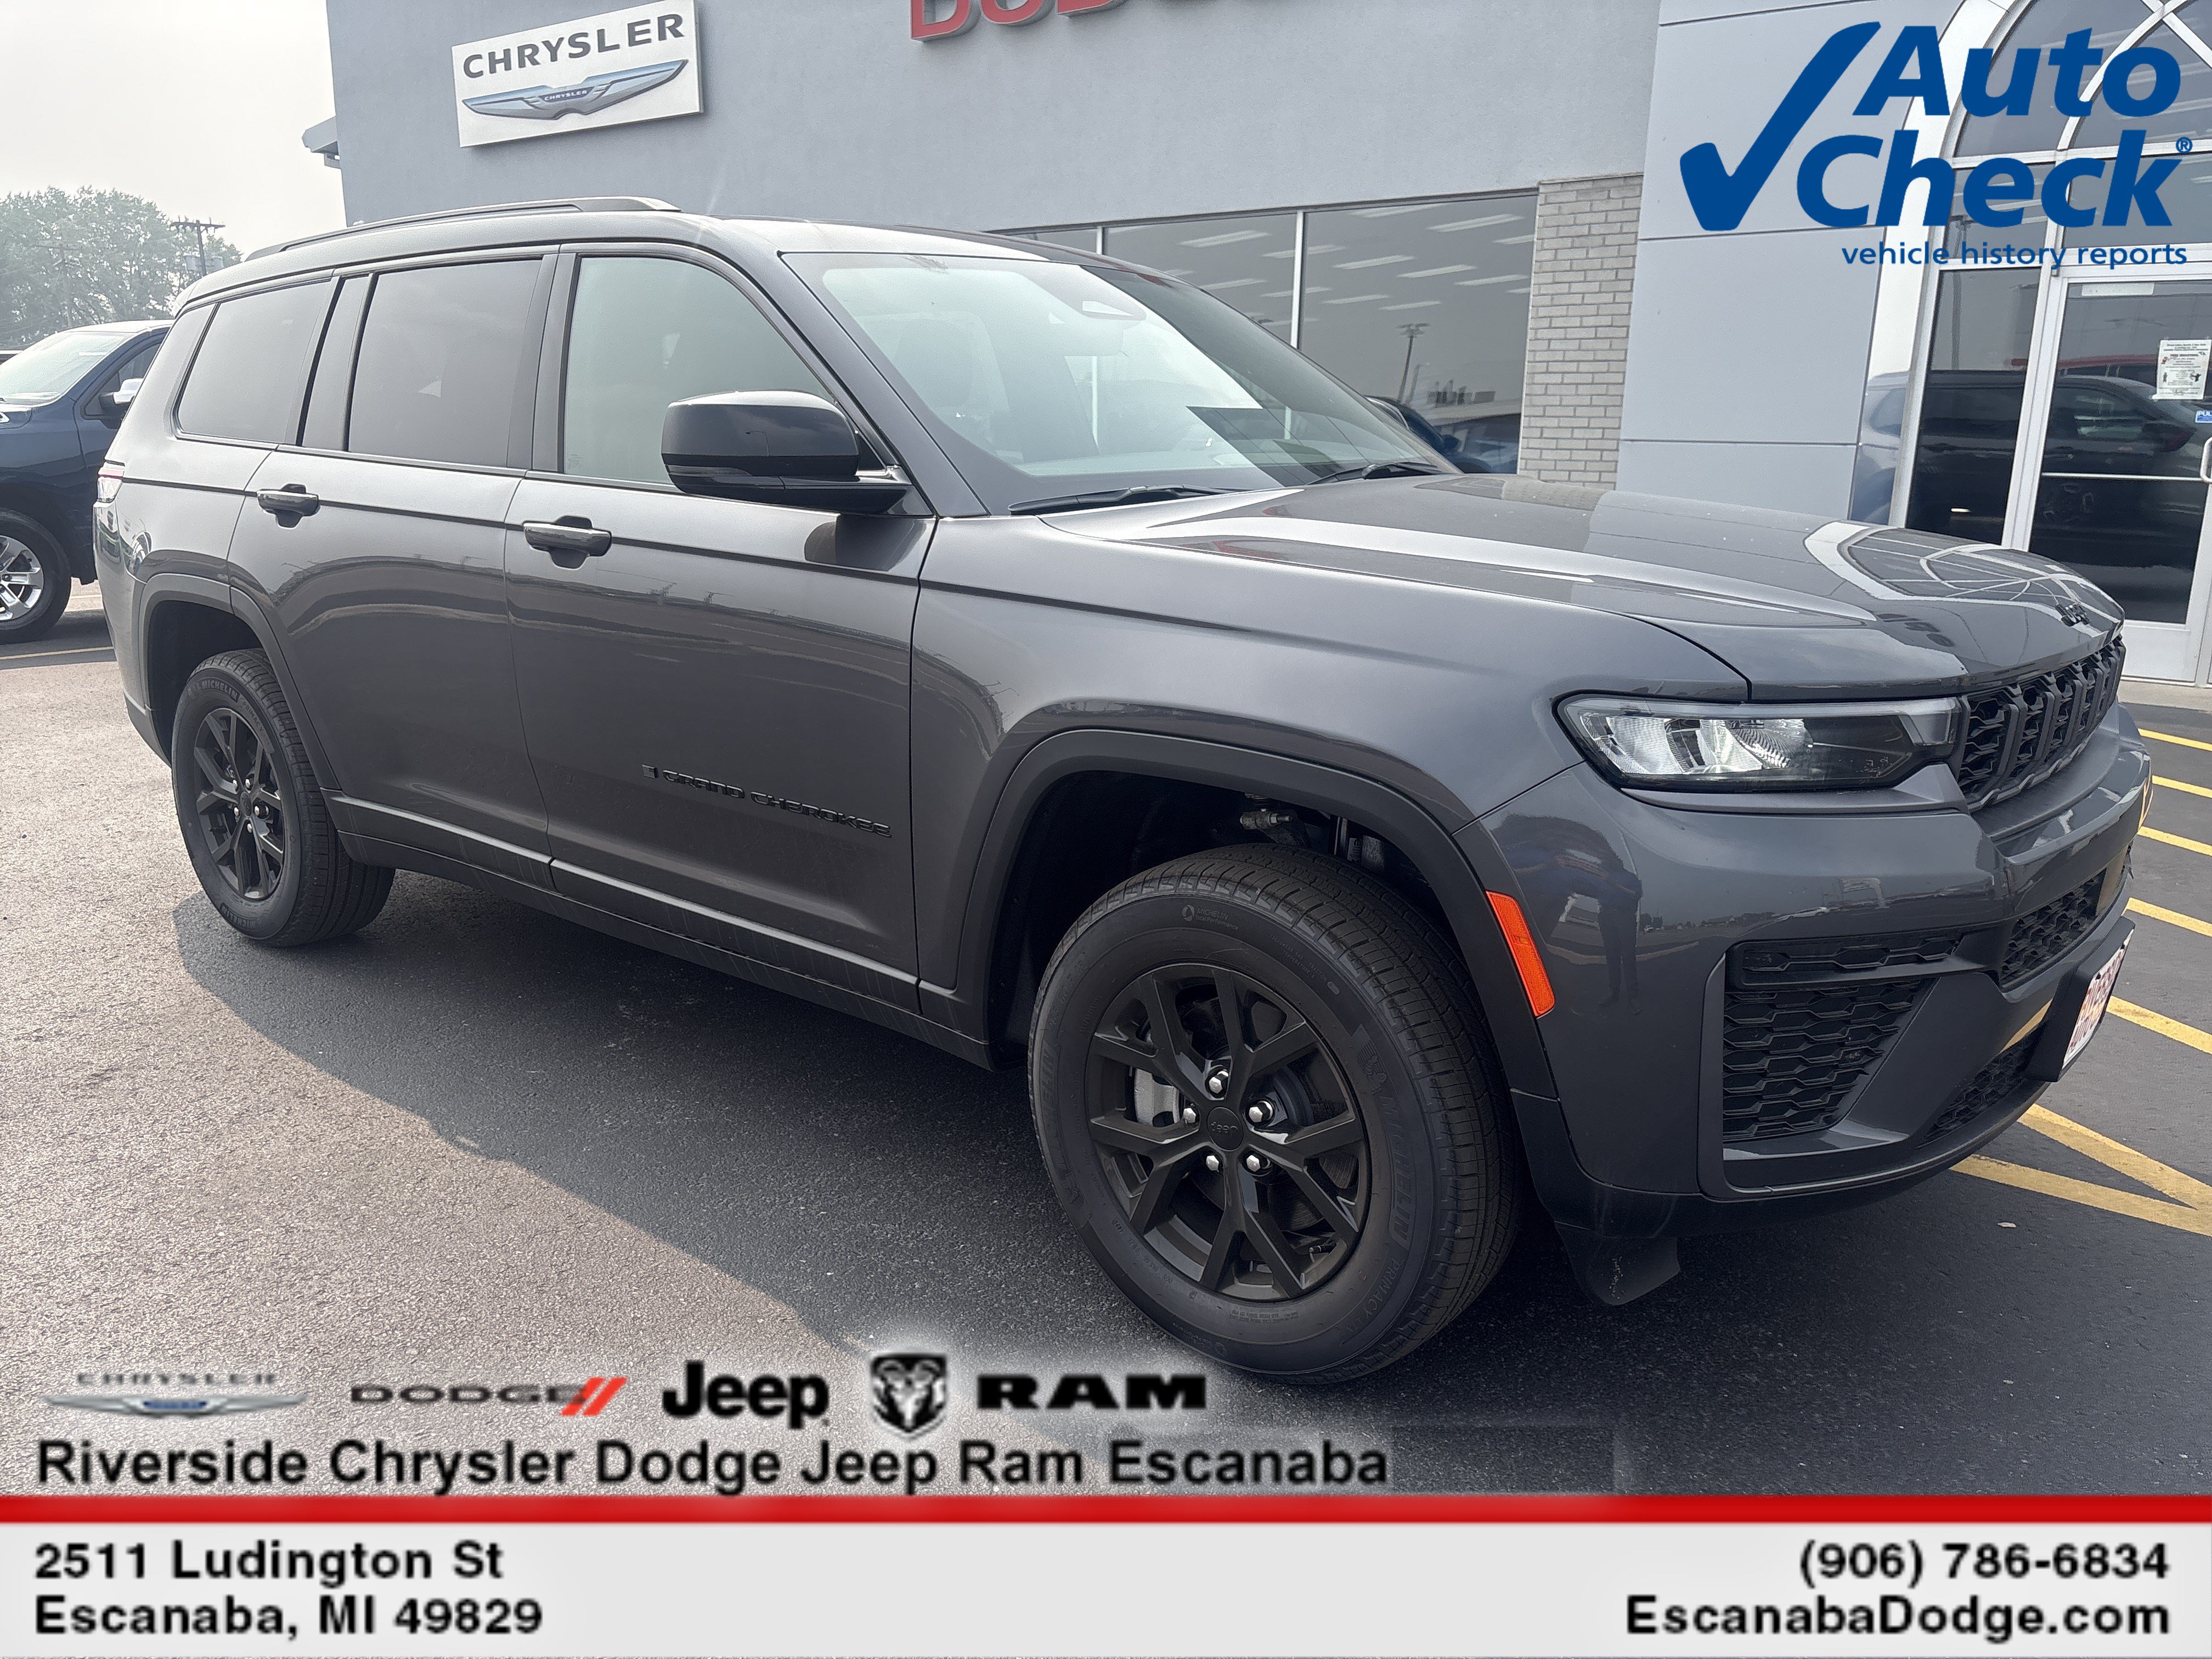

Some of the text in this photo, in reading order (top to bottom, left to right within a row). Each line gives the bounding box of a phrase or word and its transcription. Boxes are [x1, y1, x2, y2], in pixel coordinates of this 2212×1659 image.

[463, 14, 685, 78] CHRYSLER
[544, 89, 588, 102] CHRYSLER
[662, 769, 892, 839] GRAND CHEROKEE
